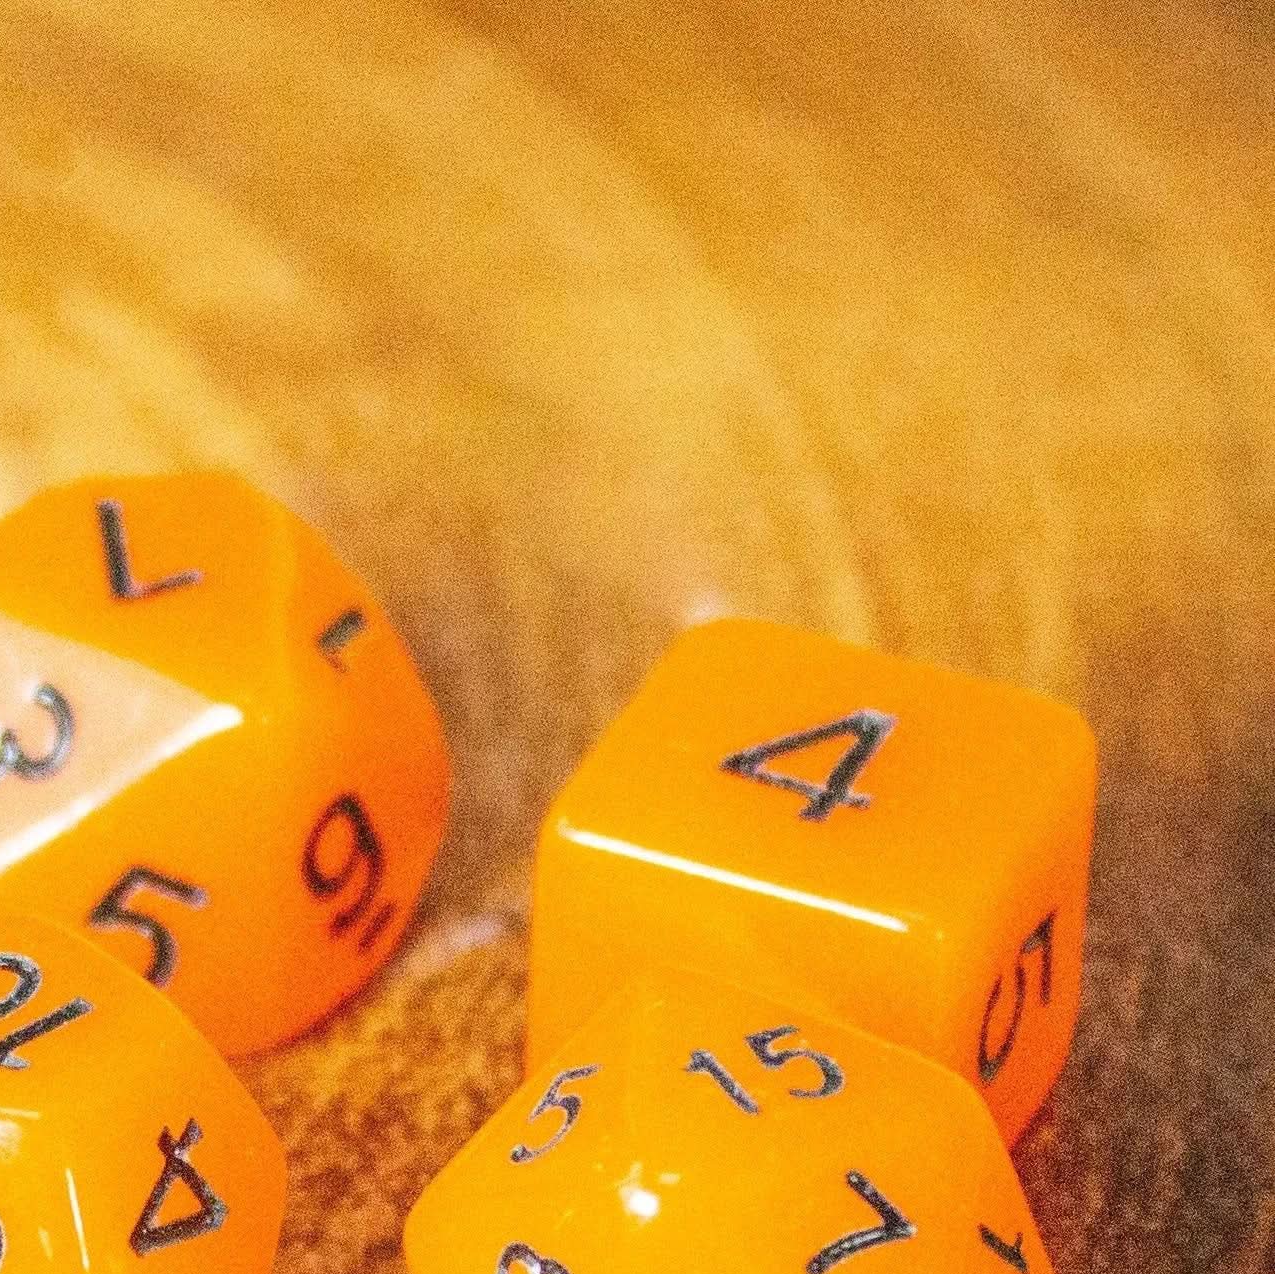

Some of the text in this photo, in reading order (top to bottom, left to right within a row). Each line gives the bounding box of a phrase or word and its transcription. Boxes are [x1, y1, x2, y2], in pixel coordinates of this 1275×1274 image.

[719, 708, 897, 822] 4
[88, 864, 209, 988] 5
[509, 1063, 603, 1164] 5
[683, 1025, 845, 1115] 15
[129, 1117, 228, 1257] 4
